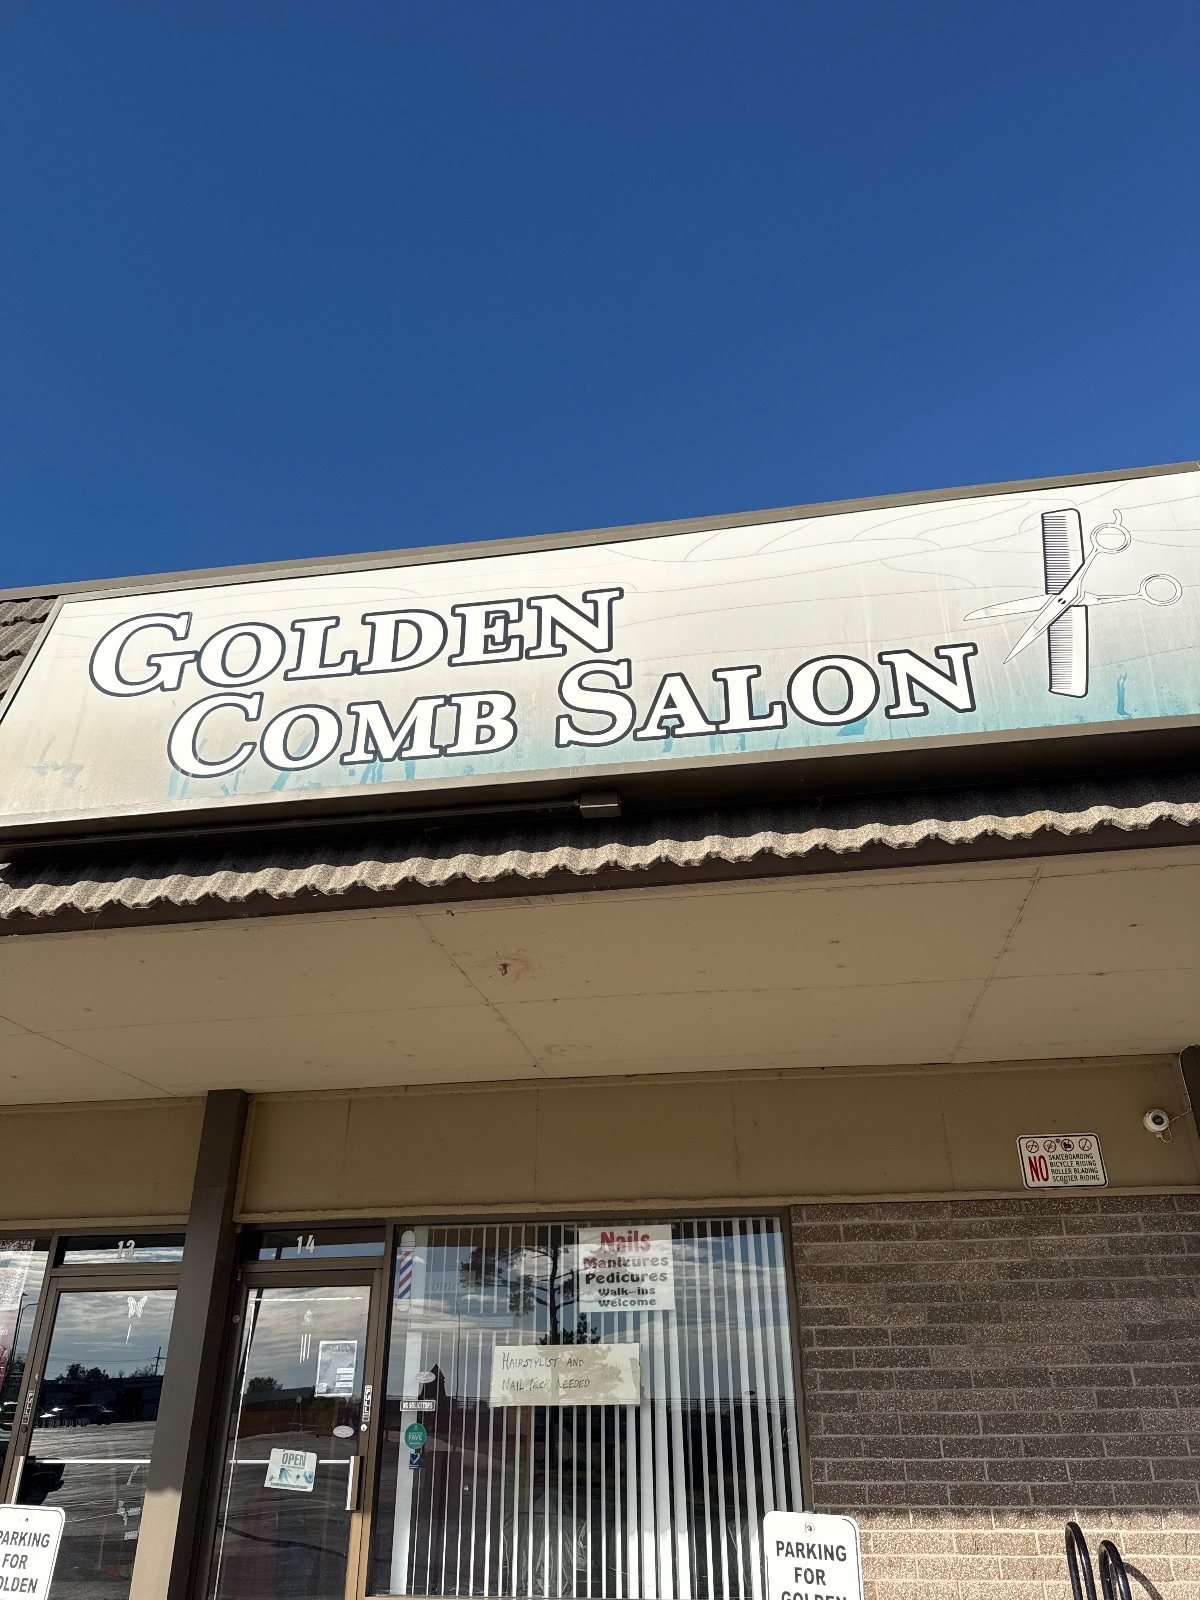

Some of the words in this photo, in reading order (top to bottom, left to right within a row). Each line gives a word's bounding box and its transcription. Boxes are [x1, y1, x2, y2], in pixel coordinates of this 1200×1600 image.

[89, 587, 624, 697] GOLDEN
[167, 690, 518, 779] COMB
[555, 642, 978, 748] SALON
[1028, 1155, 1050, 1182] NO
[117, 1239, 136, 1259] 13
[296, 1234, 315, 1255] 14
[600, 1230, 651, 1253] Nails
[583, 1256, 669, 1269] Manicures
[585, 1271, 668, 1285] Pedicures
[598, 1286, 656, 1297] Walk-ins
[598, 1298, 657, 1308] Welcome
[566, 1358, 584, 1367] AND
[502, 1379, 525, 1391] NAIL
[556, 1378, 590, 1389] NEEDED
[281, 1452, 307, 1466] OPEN
[776, 1540, 847, 1562] PARKING
[2, 1553, 28, 1569] FOR
[0, 1576, 38, 1593] LDEN
[794, 1567, 827, 1586] FOR
